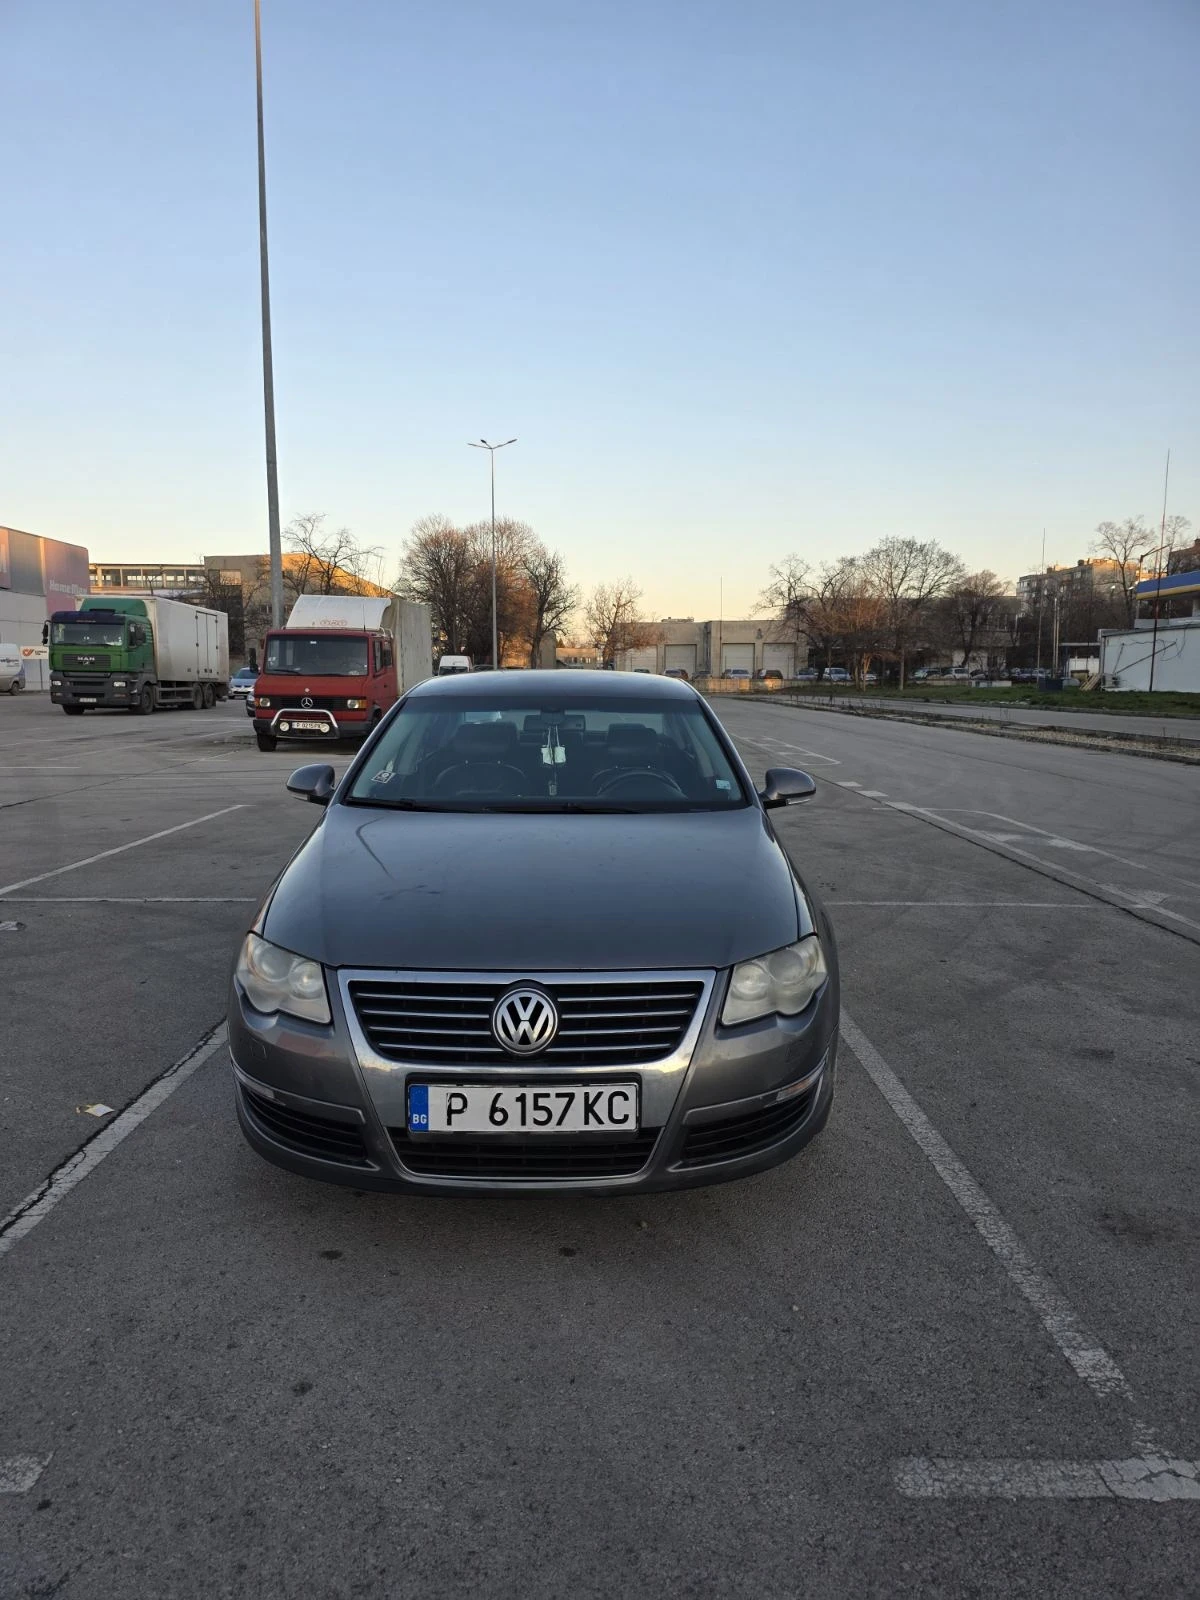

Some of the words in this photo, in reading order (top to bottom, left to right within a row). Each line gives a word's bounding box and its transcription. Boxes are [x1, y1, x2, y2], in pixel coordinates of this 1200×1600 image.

[412, 1113, 427, 1124] BG
[446, 1092, 468, 1126] P
[489, 1091, 575, 1127] 6157
[583, 1090, 630, 1126] KC
